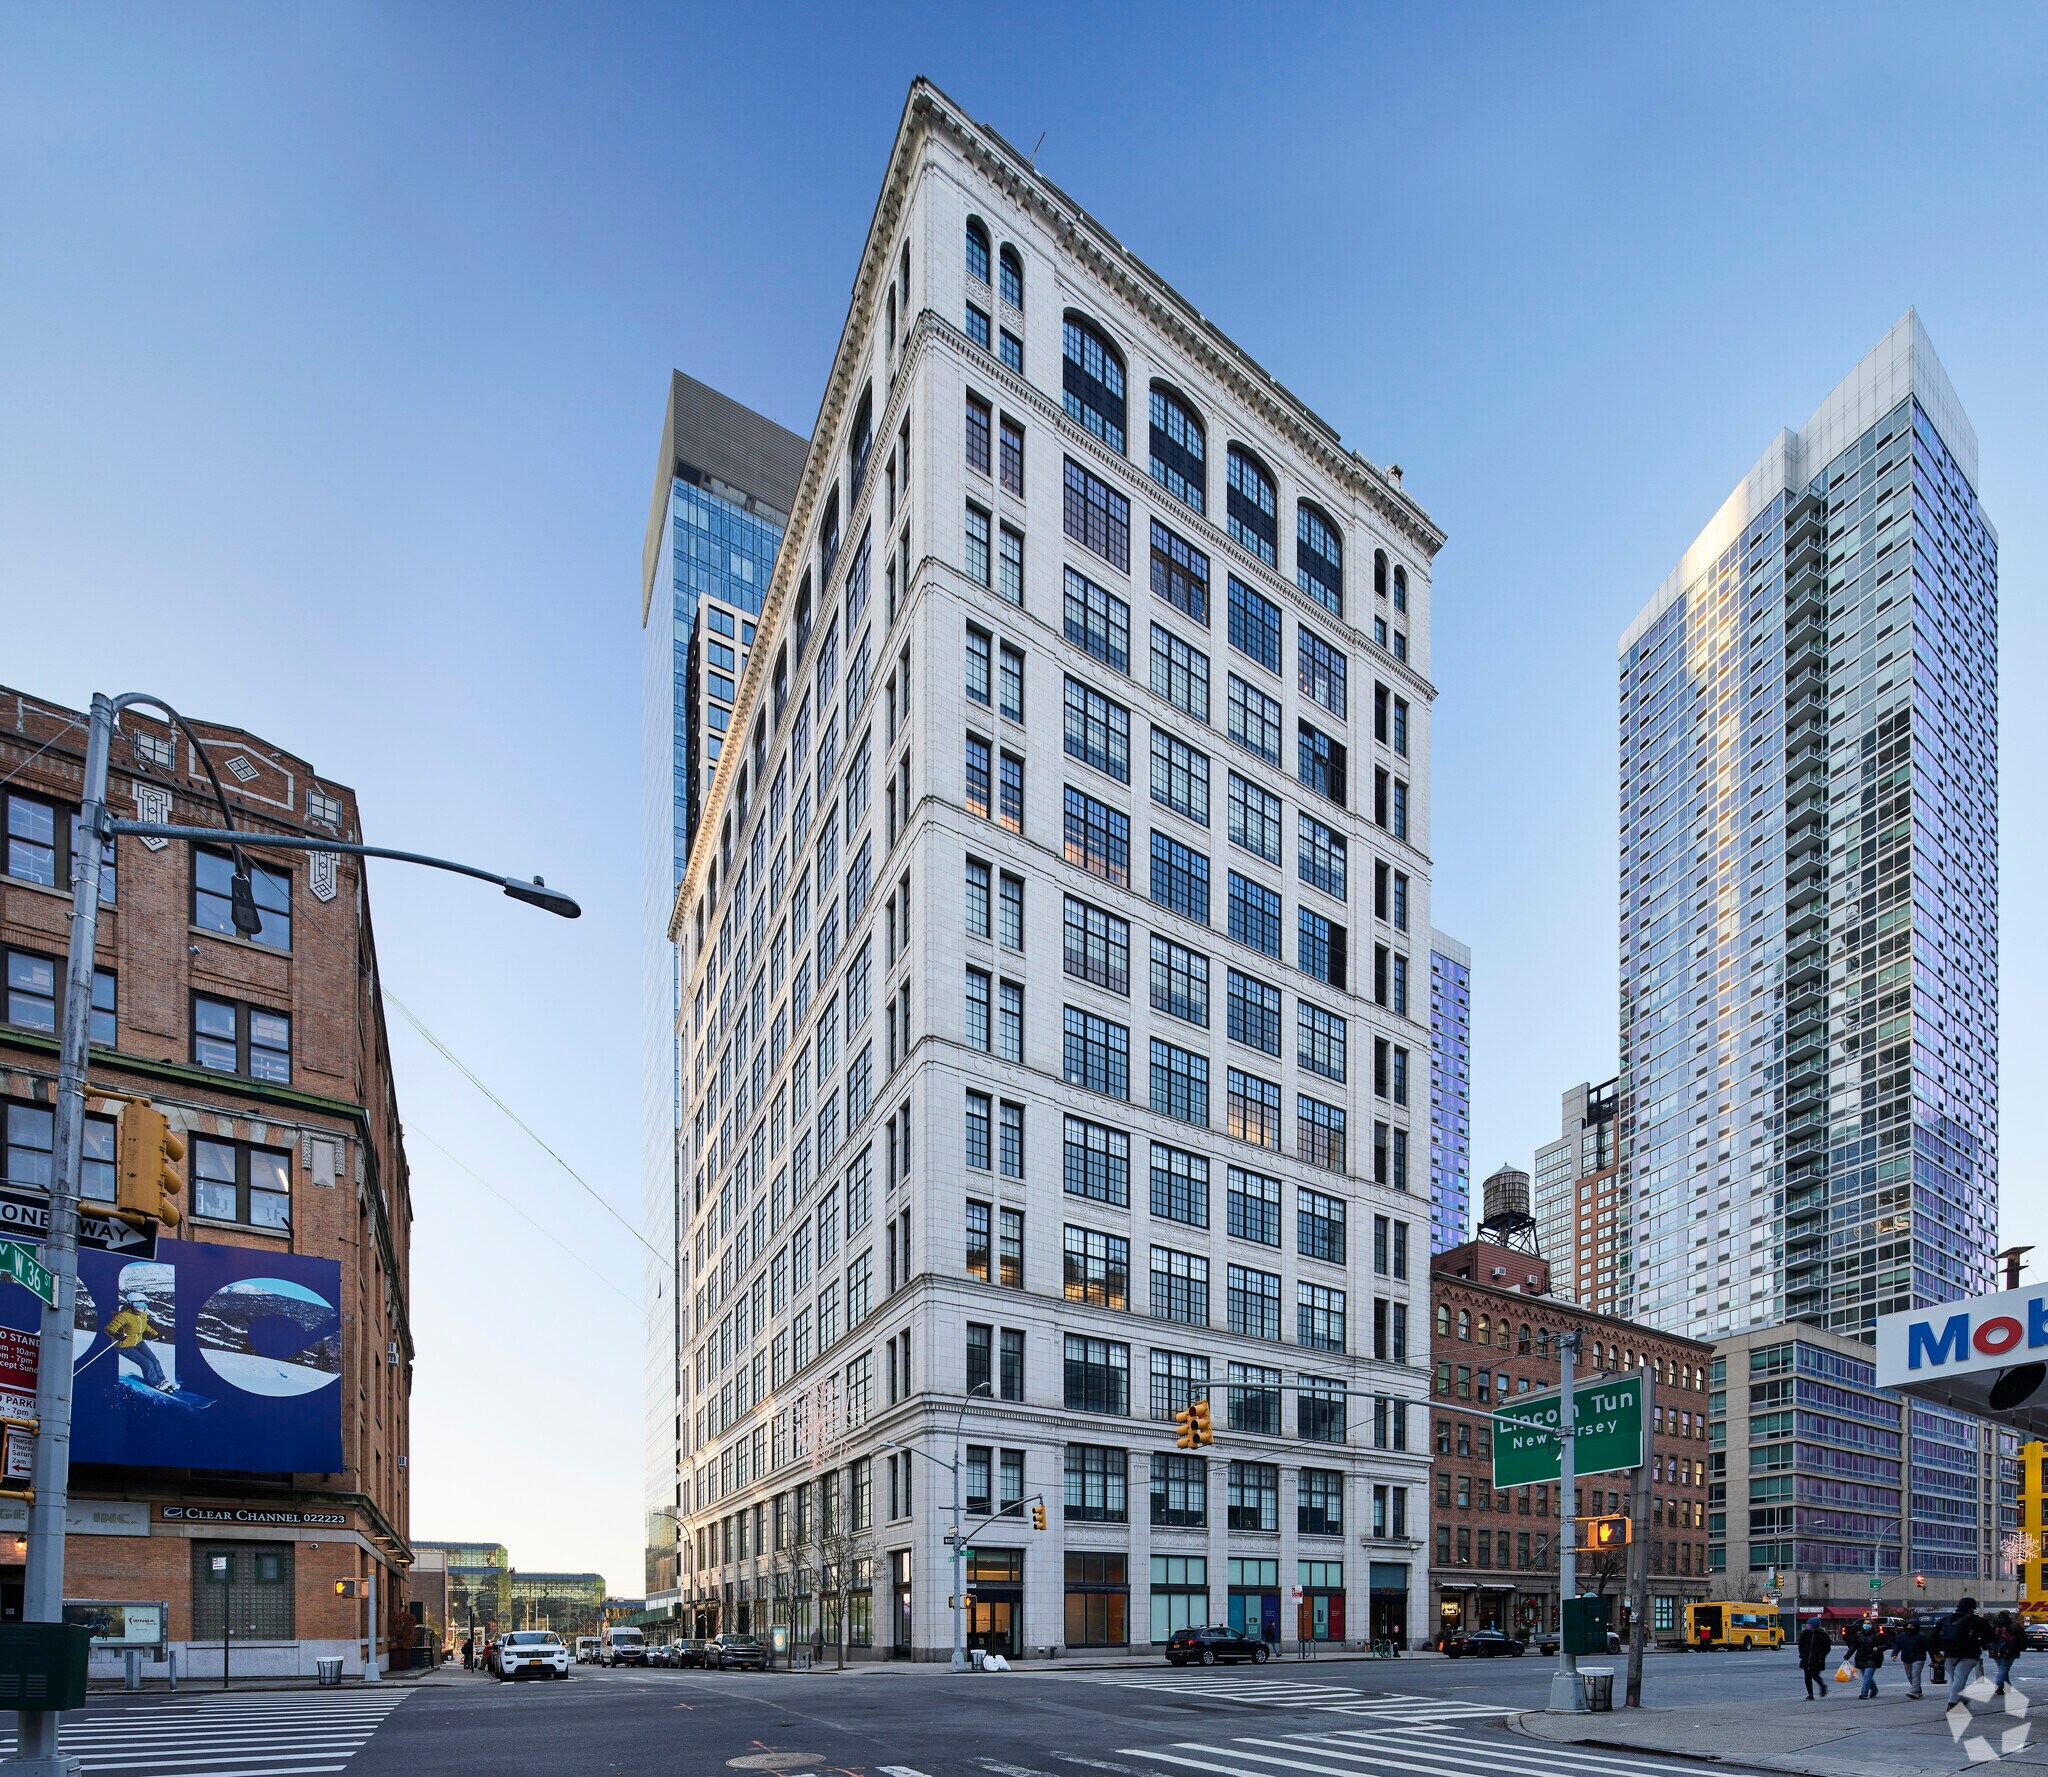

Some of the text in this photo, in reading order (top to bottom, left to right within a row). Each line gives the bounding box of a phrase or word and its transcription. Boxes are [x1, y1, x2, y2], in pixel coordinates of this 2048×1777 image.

[2, 1204, 131, 1243] ONE WAY
[14, 1250, 51, 1292] W 36 ST
[16, 1347, 36, 1358] 10am
[16, 1354, 33, 1365] 7pm
[12, 1406, 29, 1416] 7pm
[1591, 1392, 1633, 1414] Tun
[1513, 1433, 1547, 1449] New
[12, 1457, 27, 1465] 2am
[186, 1508, 345, 1524] CLEAR CHANNEL 022223
